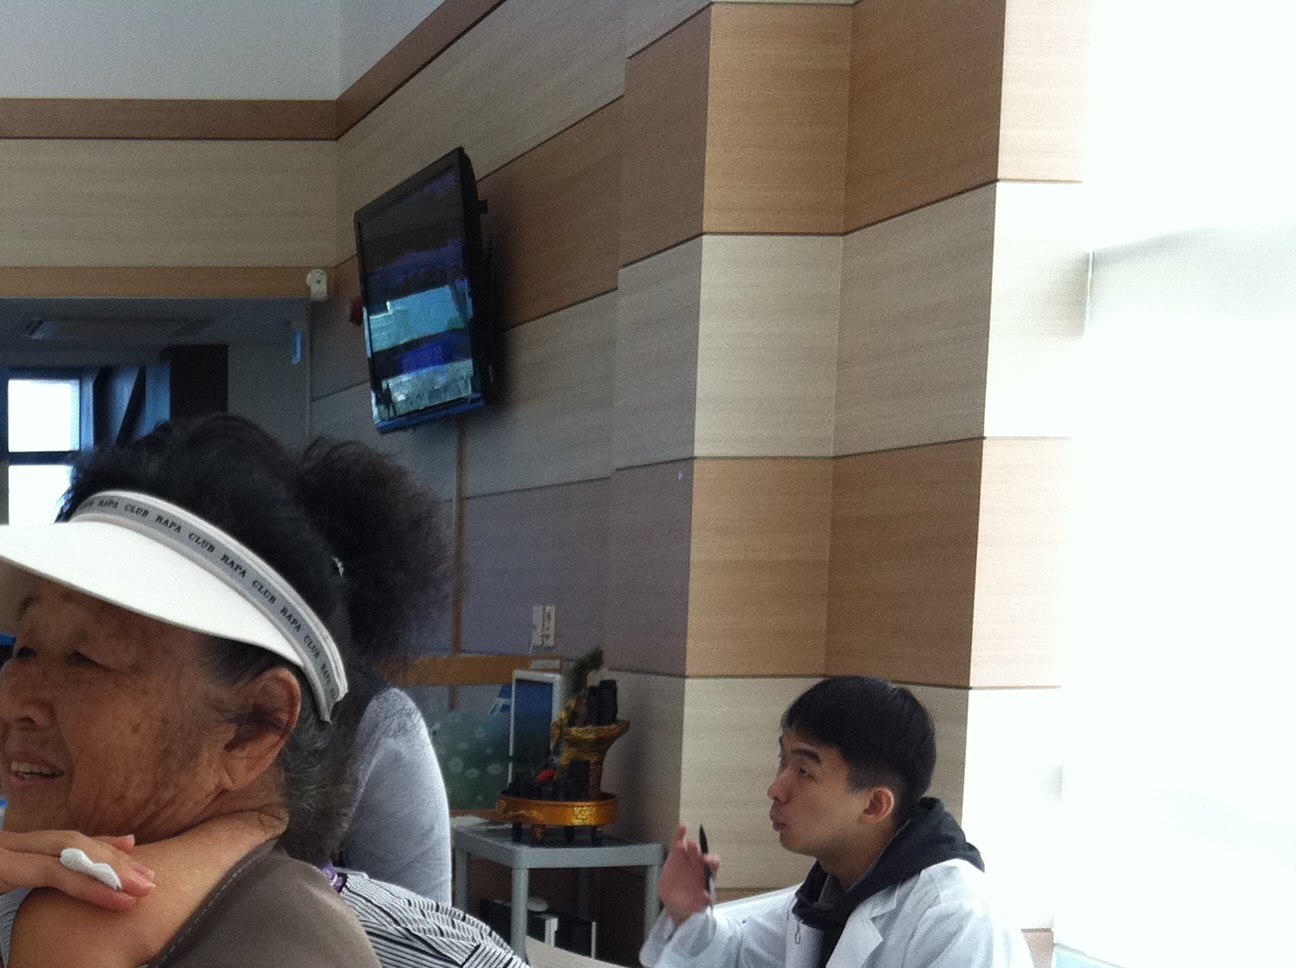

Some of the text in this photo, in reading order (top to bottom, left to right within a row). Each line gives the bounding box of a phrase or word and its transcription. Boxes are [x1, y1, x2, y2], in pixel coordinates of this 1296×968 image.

[124, 504, 150, 518] CLUB
[188, 532, 216, 553] CLUB
[220, 554, 247, 578] RAPA
[252, 580, 277, 604] CLUB
